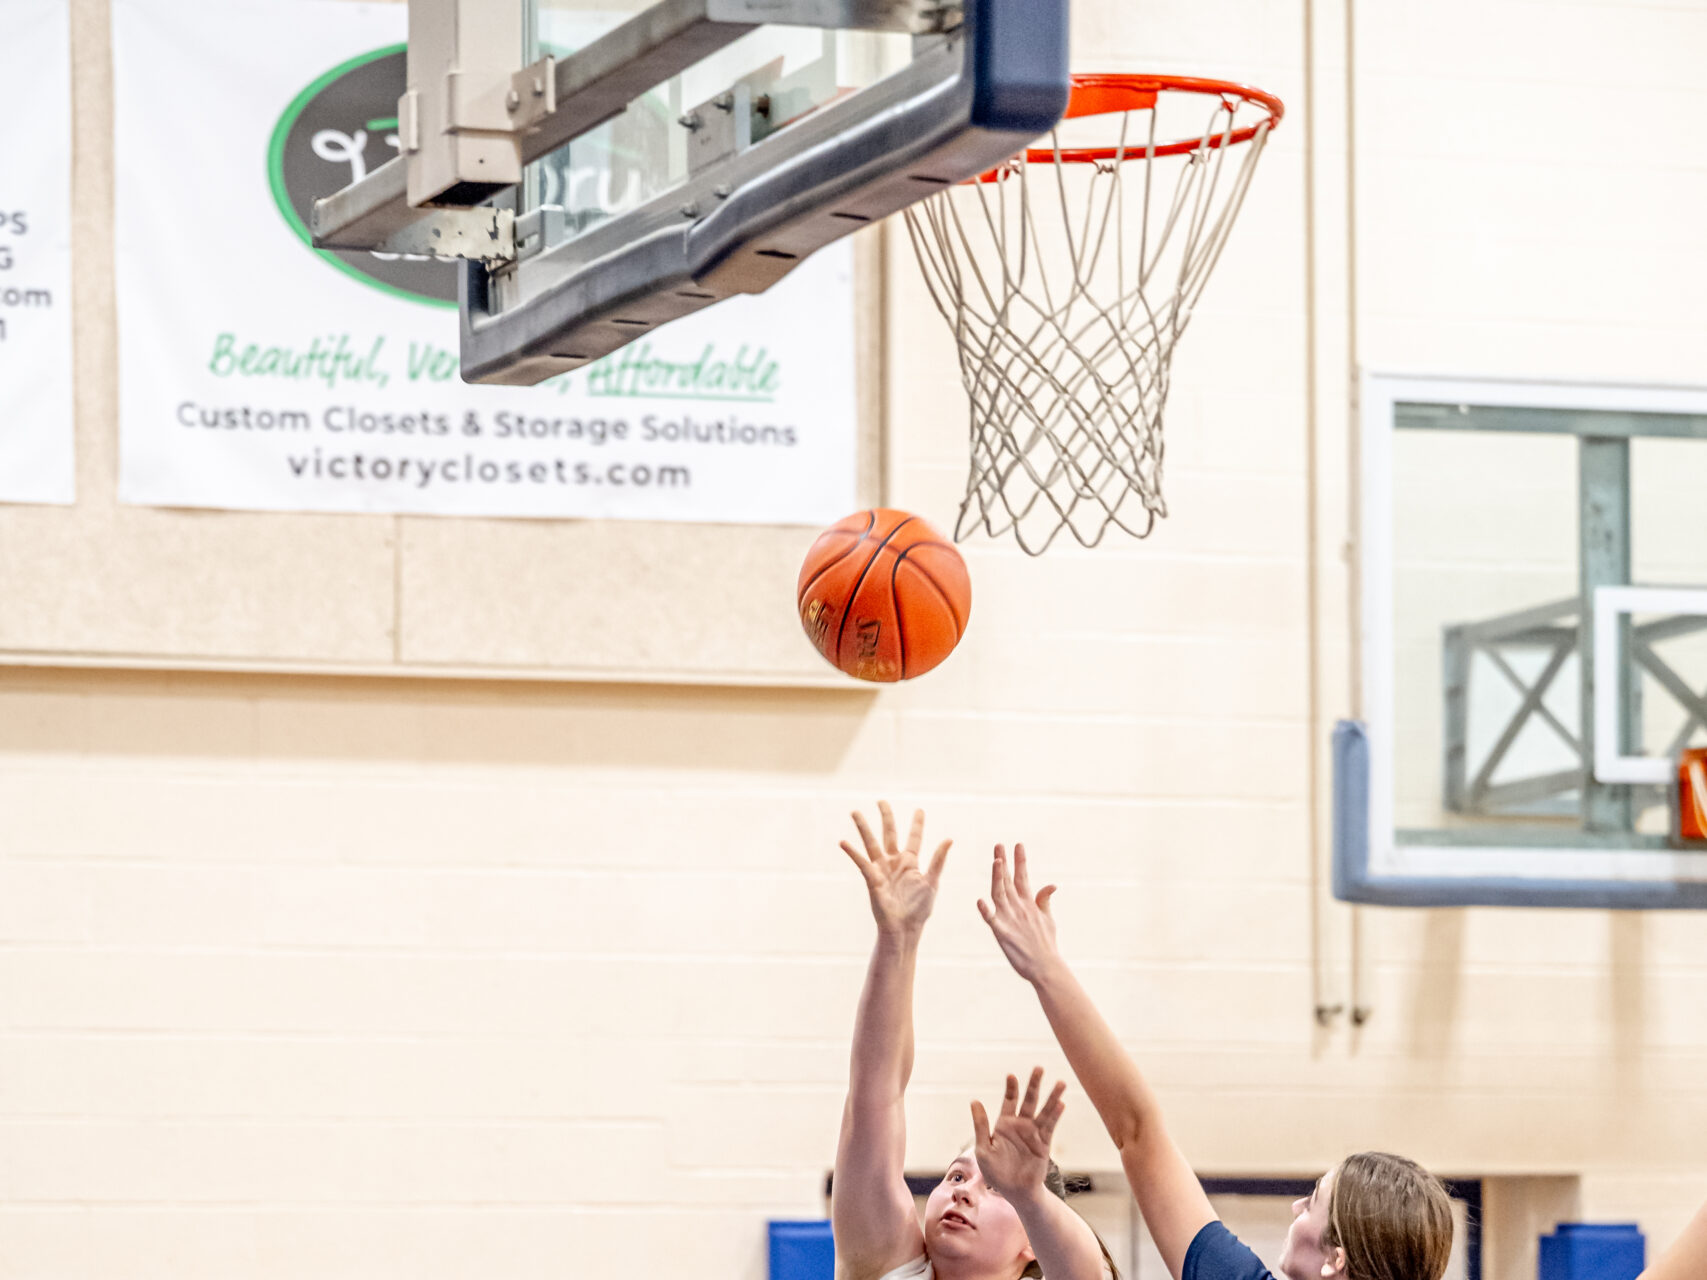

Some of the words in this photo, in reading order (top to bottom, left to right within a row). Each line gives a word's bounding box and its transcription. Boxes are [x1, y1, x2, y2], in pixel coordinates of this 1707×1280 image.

[207, 332, 390, 389] Beautiful,
[587, 343, 780, 395] Affordable
[176, 401, 312, 430] Custom
[323, 406, 449, 436] Closets
[461, 409, 483, 437] &
[494, 411, 630, 446] Storage
[641, 414, 798, 446] Solutions
[288, 447, 692, 488] victoryclosets.com
